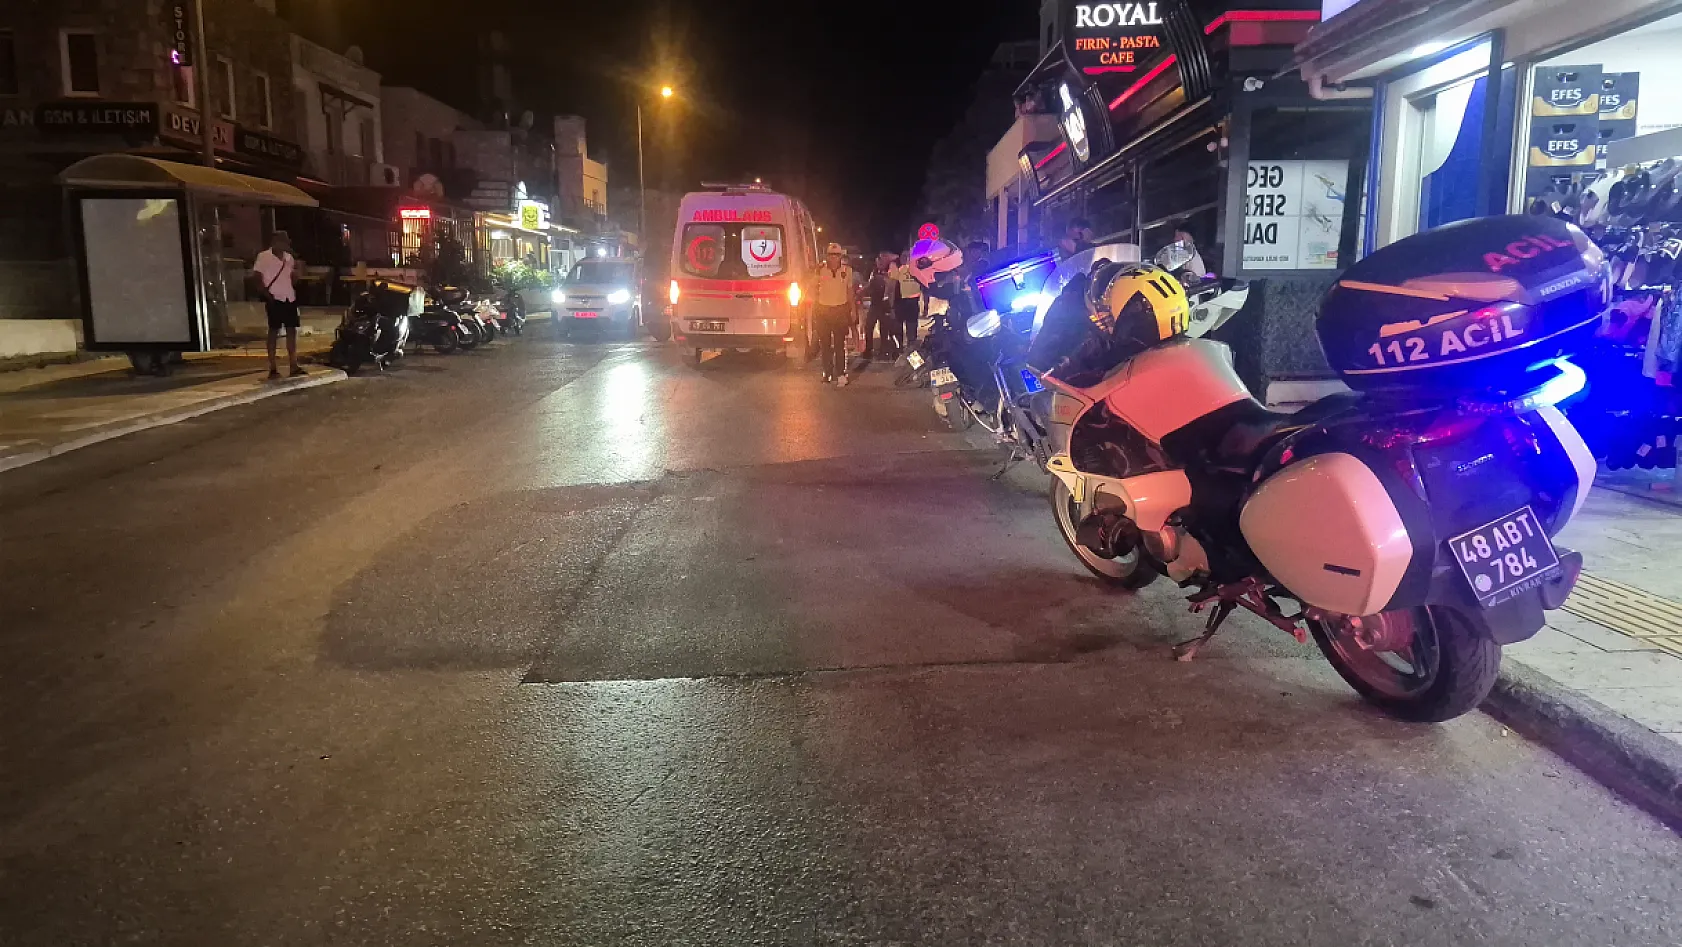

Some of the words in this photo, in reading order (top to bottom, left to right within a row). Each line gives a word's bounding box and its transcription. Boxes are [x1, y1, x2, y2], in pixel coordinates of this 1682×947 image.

[1075, 2, 1164, 27] ROYAL
[1075, 37, 1110, 51] FIRIN
[1120, 35, 1160, 49] PASTA
[1100, 51, 1135, 65] CAFE
[1551, 88, 1582, 101] EFES
[1600, 94, 1621, 106] FES
[1548, 139, 1579, 152] EFES
[1597, 144, 1609, 154] FE
[693, 209, 773, 222] AMBULANS
[1540, 276, 1582, 297] HONDA
[1368, 338, 1430, 366] 112
[1461, 534, 1492, 563] 48
[1492, 513, 1534, 552] ABT
[1490, 547, 1537, 583] 784
